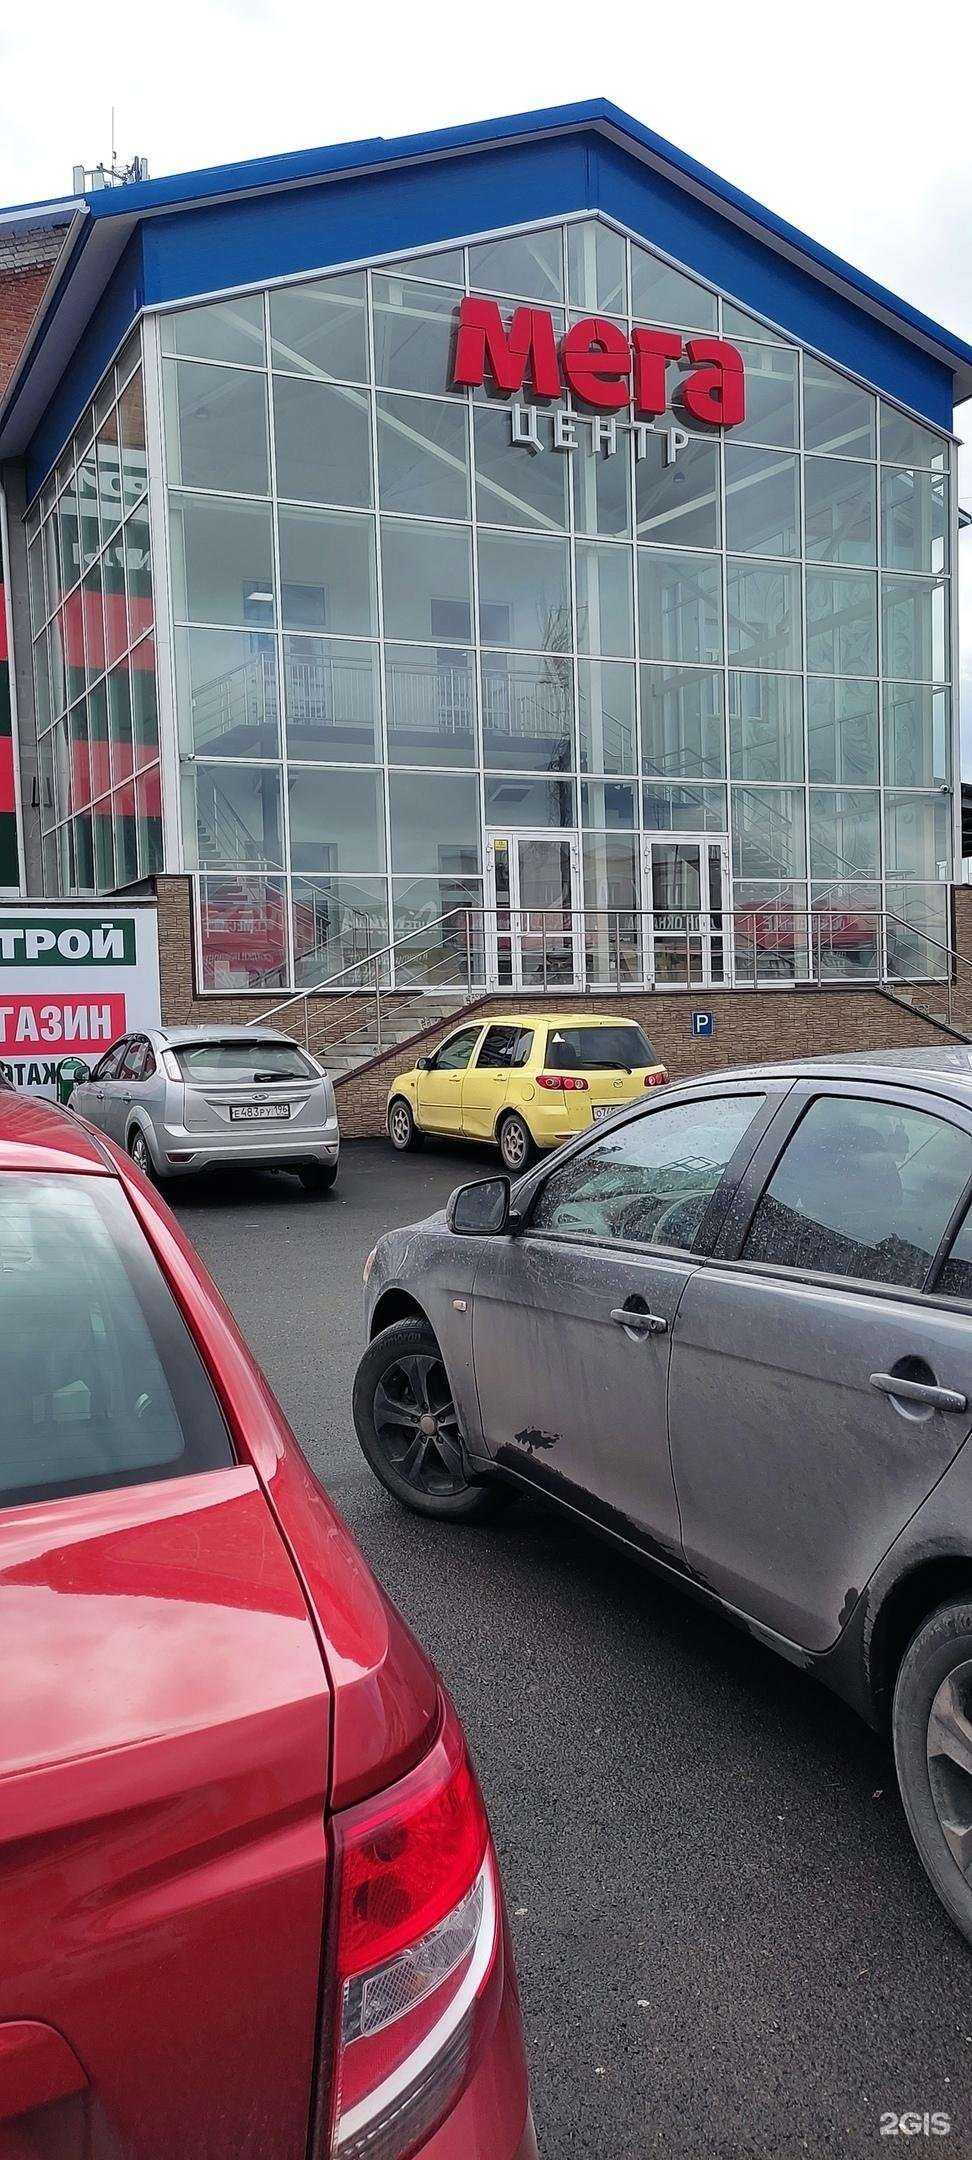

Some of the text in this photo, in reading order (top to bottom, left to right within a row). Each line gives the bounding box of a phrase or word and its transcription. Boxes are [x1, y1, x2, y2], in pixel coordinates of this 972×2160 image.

[511, 402, 690, 465] ЦЕНТР
[0, 923, 125, 959] ТРОЙ
[696, 1014, 710, 1033] P
